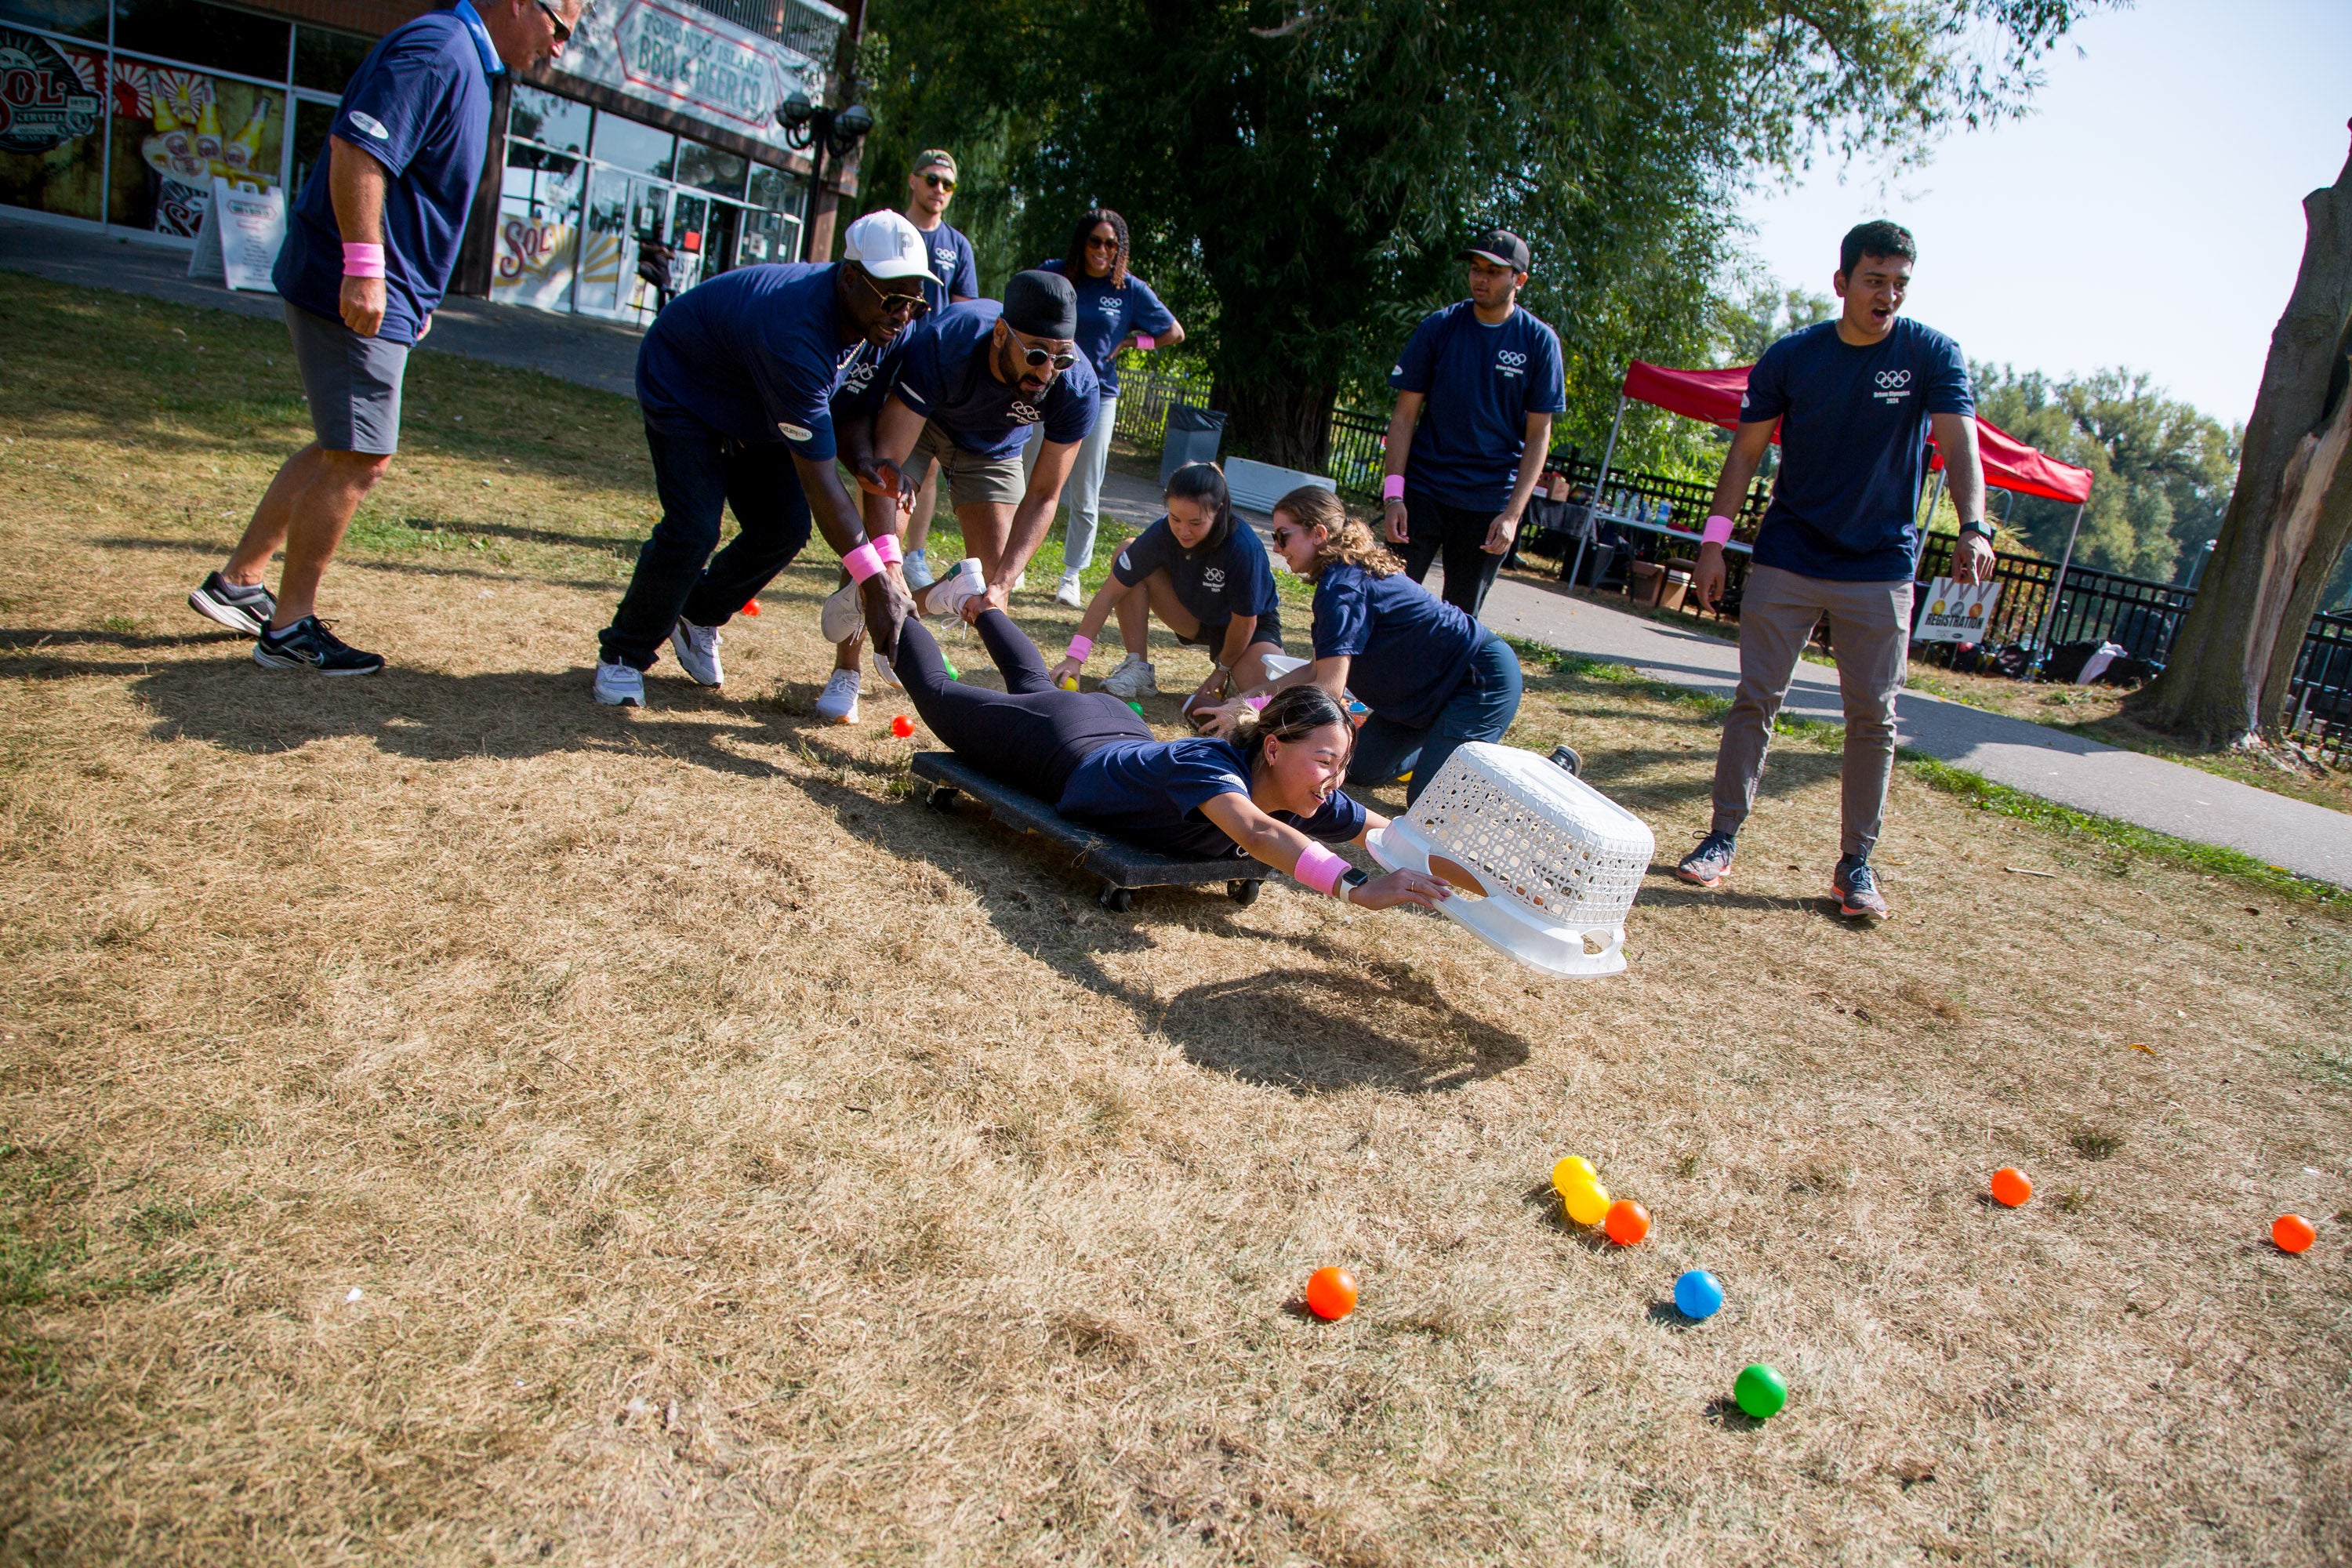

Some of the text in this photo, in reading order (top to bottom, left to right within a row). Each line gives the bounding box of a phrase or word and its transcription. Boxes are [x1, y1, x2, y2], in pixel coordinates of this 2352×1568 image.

[637, 33, 675, 81] BBQ
[695, 57, 736, 106] BEER
[644, 12, 712, 56] TORONTO
[717, 45, 764, 77] ISLAND
[17, 113, 64, 122] CERVEZA
[499, 220, 552, 279] SOL
[1925, 613, 1984, 630] REGISTRATION
